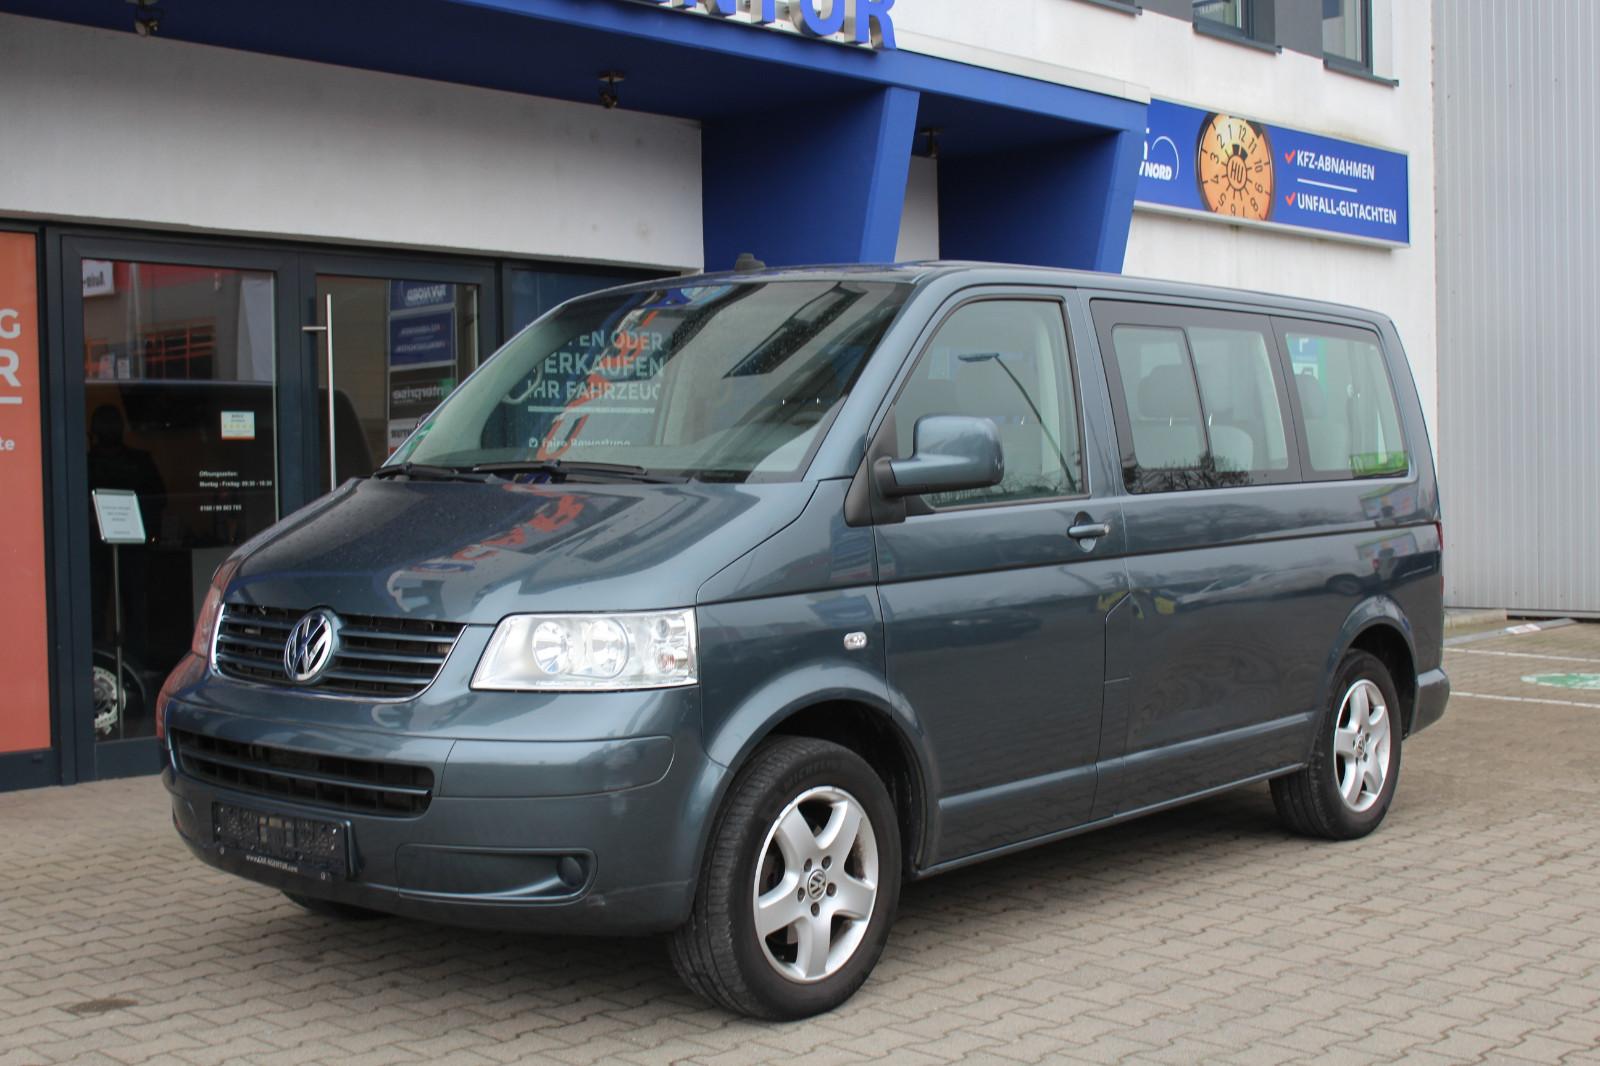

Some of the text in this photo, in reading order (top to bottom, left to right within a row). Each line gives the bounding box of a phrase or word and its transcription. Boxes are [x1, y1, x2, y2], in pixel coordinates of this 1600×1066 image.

[1216, 133, 1226, 148] 2
[1238, 125, 1247, 143] 12
[1248, 137, 1257, 154] 11
[1210, 152, 1220, 164] 3
[1254, 159, 1264, 173] 10
[1297, 150, 1375, 181] KFZ-ABNAHMEN
[1144, 161, 1172, 181] NORD
[1210, 174, 1220, 184] 4
[1230, 161, 1243, 184] HU
[1218, 192, 1227, 206] 5
[1250, 197, 1259, 212] 8
[1297, 193, 1397, 225] UNFALL-GUTACHTEN
[610, 329, 664, 351] ODER
[533, 351, 664, 377] ERKAUFEN
[527, 378, 560, 399] IHR
